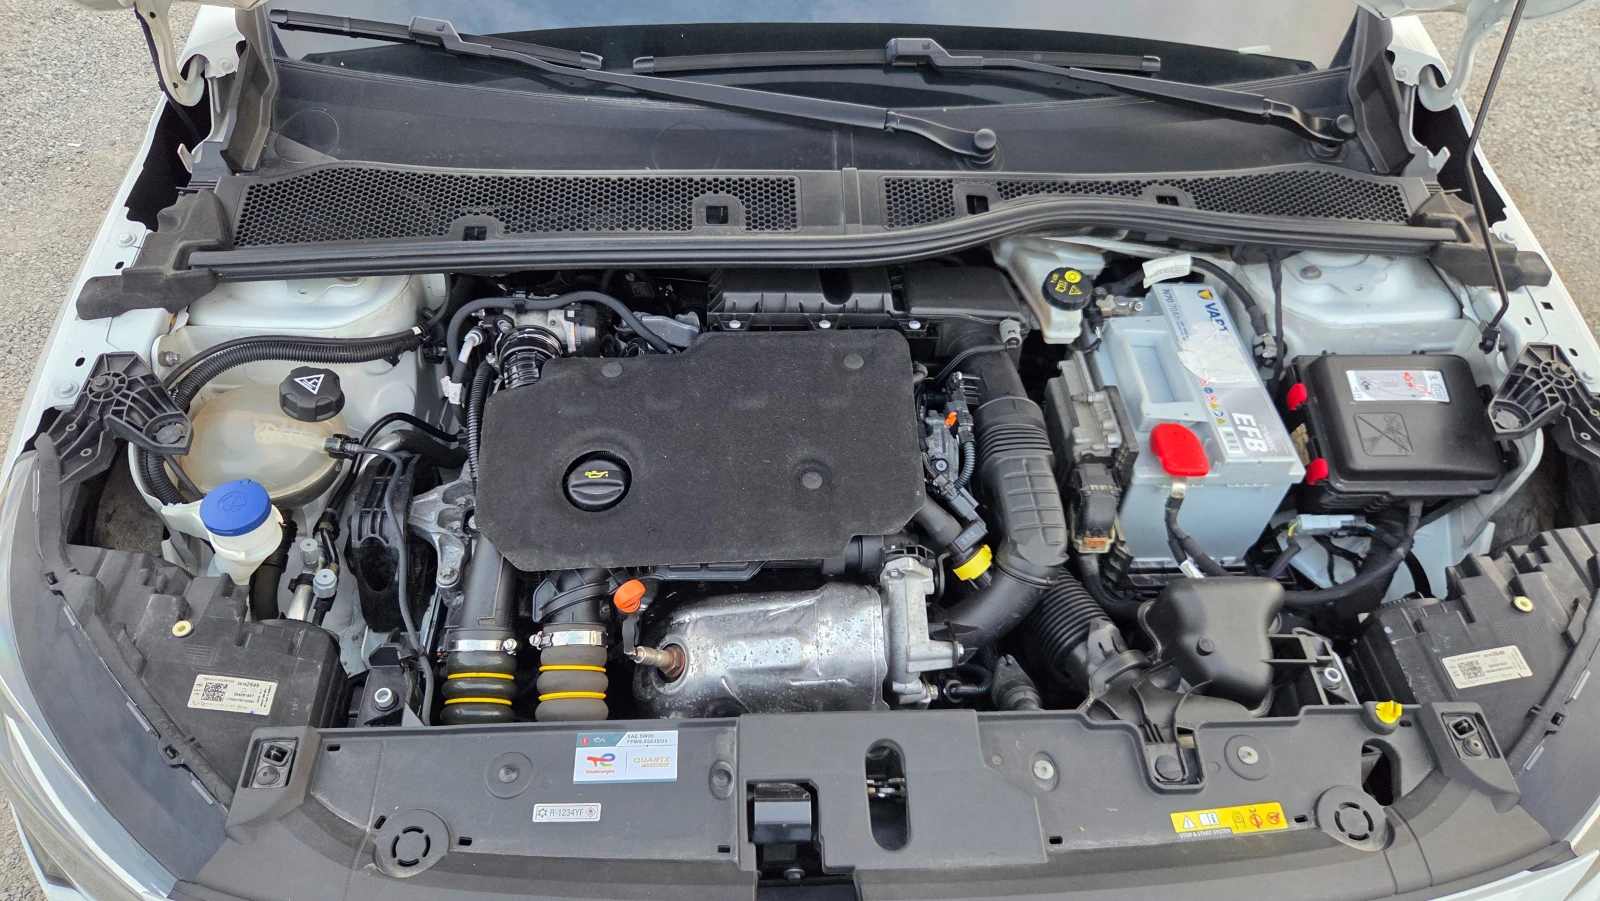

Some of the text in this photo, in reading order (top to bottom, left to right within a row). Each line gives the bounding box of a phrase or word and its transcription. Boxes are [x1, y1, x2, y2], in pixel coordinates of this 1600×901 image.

[1162, 289, 1173, 303] N70
[1231, 413, 1268, 452] EFB
[1259, 424, 1277, 452] DYNAMIC
